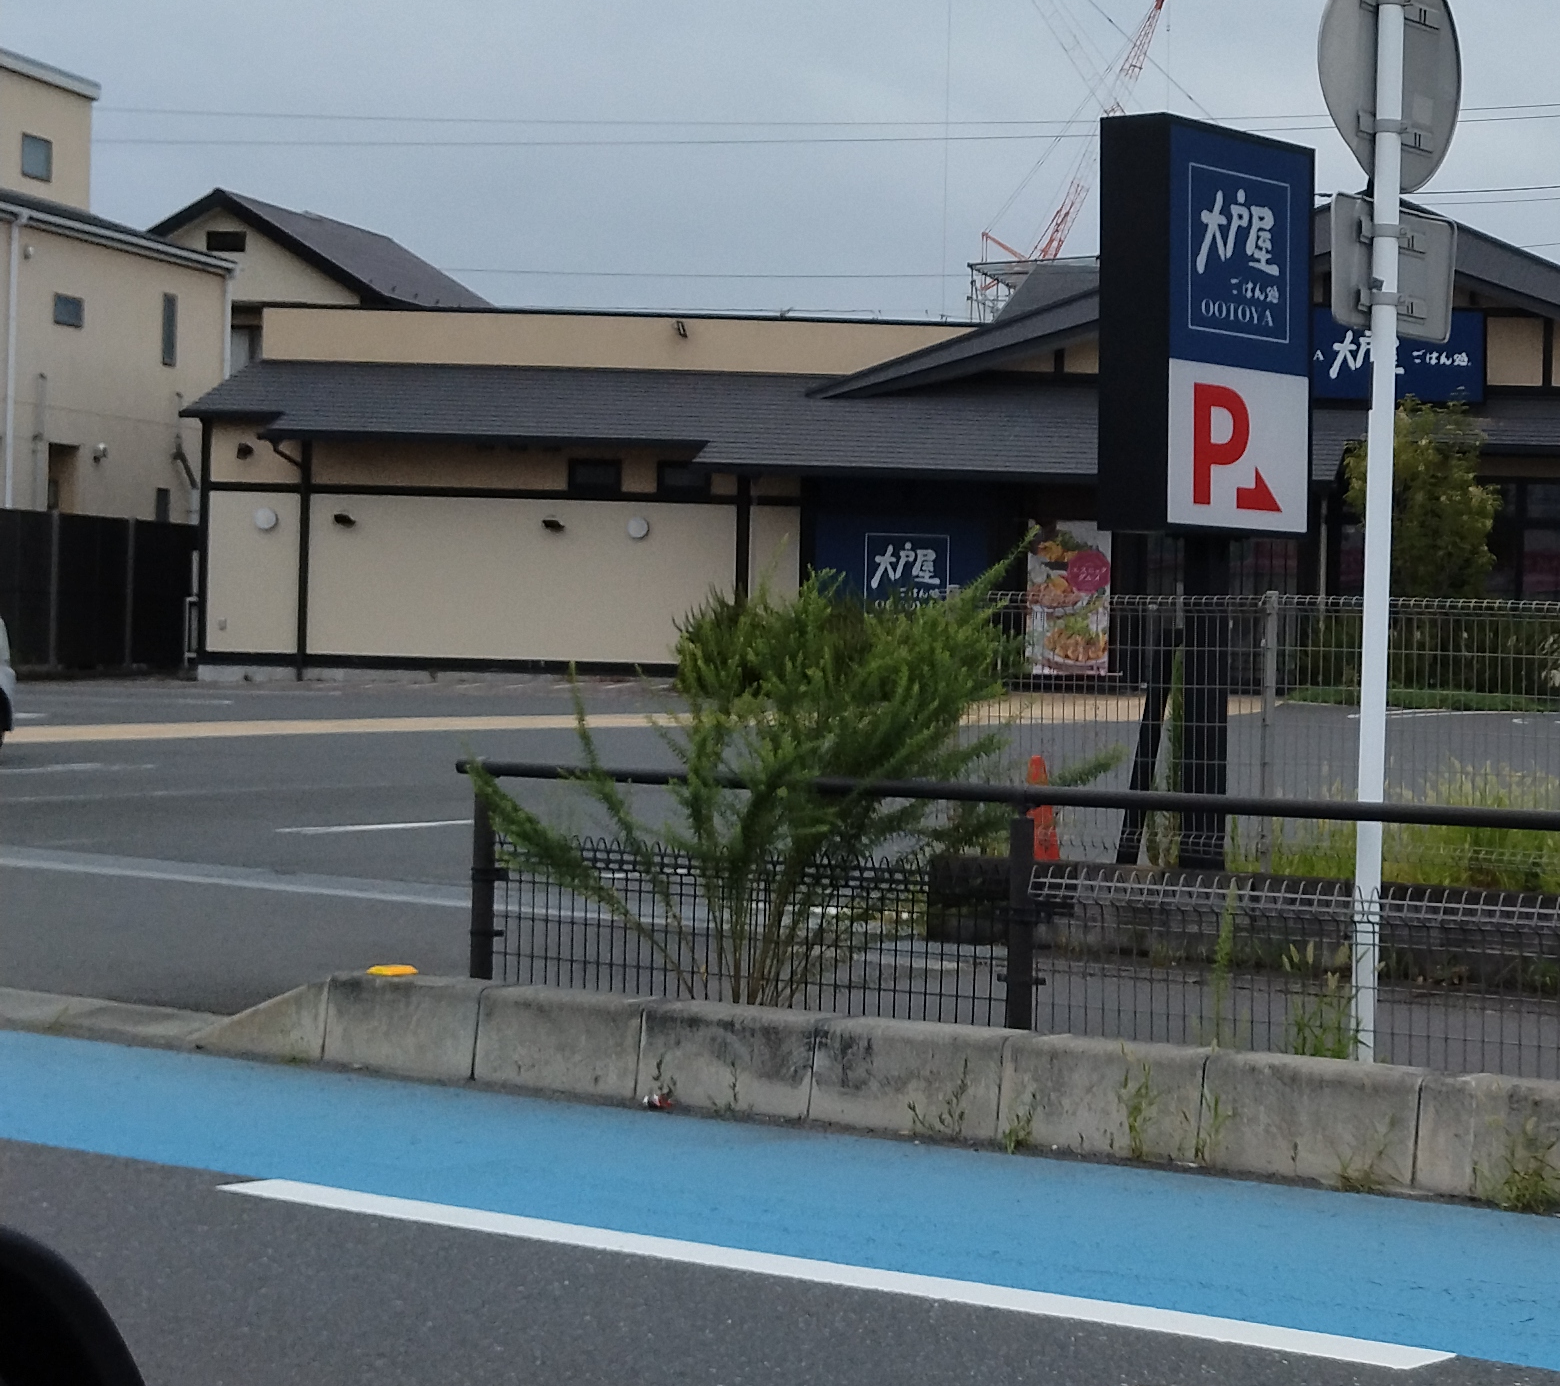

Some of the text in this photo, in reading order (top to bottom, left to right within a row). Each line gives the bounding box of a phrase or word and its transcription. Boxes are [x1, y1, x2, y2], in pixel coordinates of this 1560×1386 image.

[1196, 189, 1280, 276] 大戸屋
[1201, 298, 1274, 327] OOTOYA
[1193, 382, 1249, 505] P
[870, 541, 941, 589] 大戸屋
